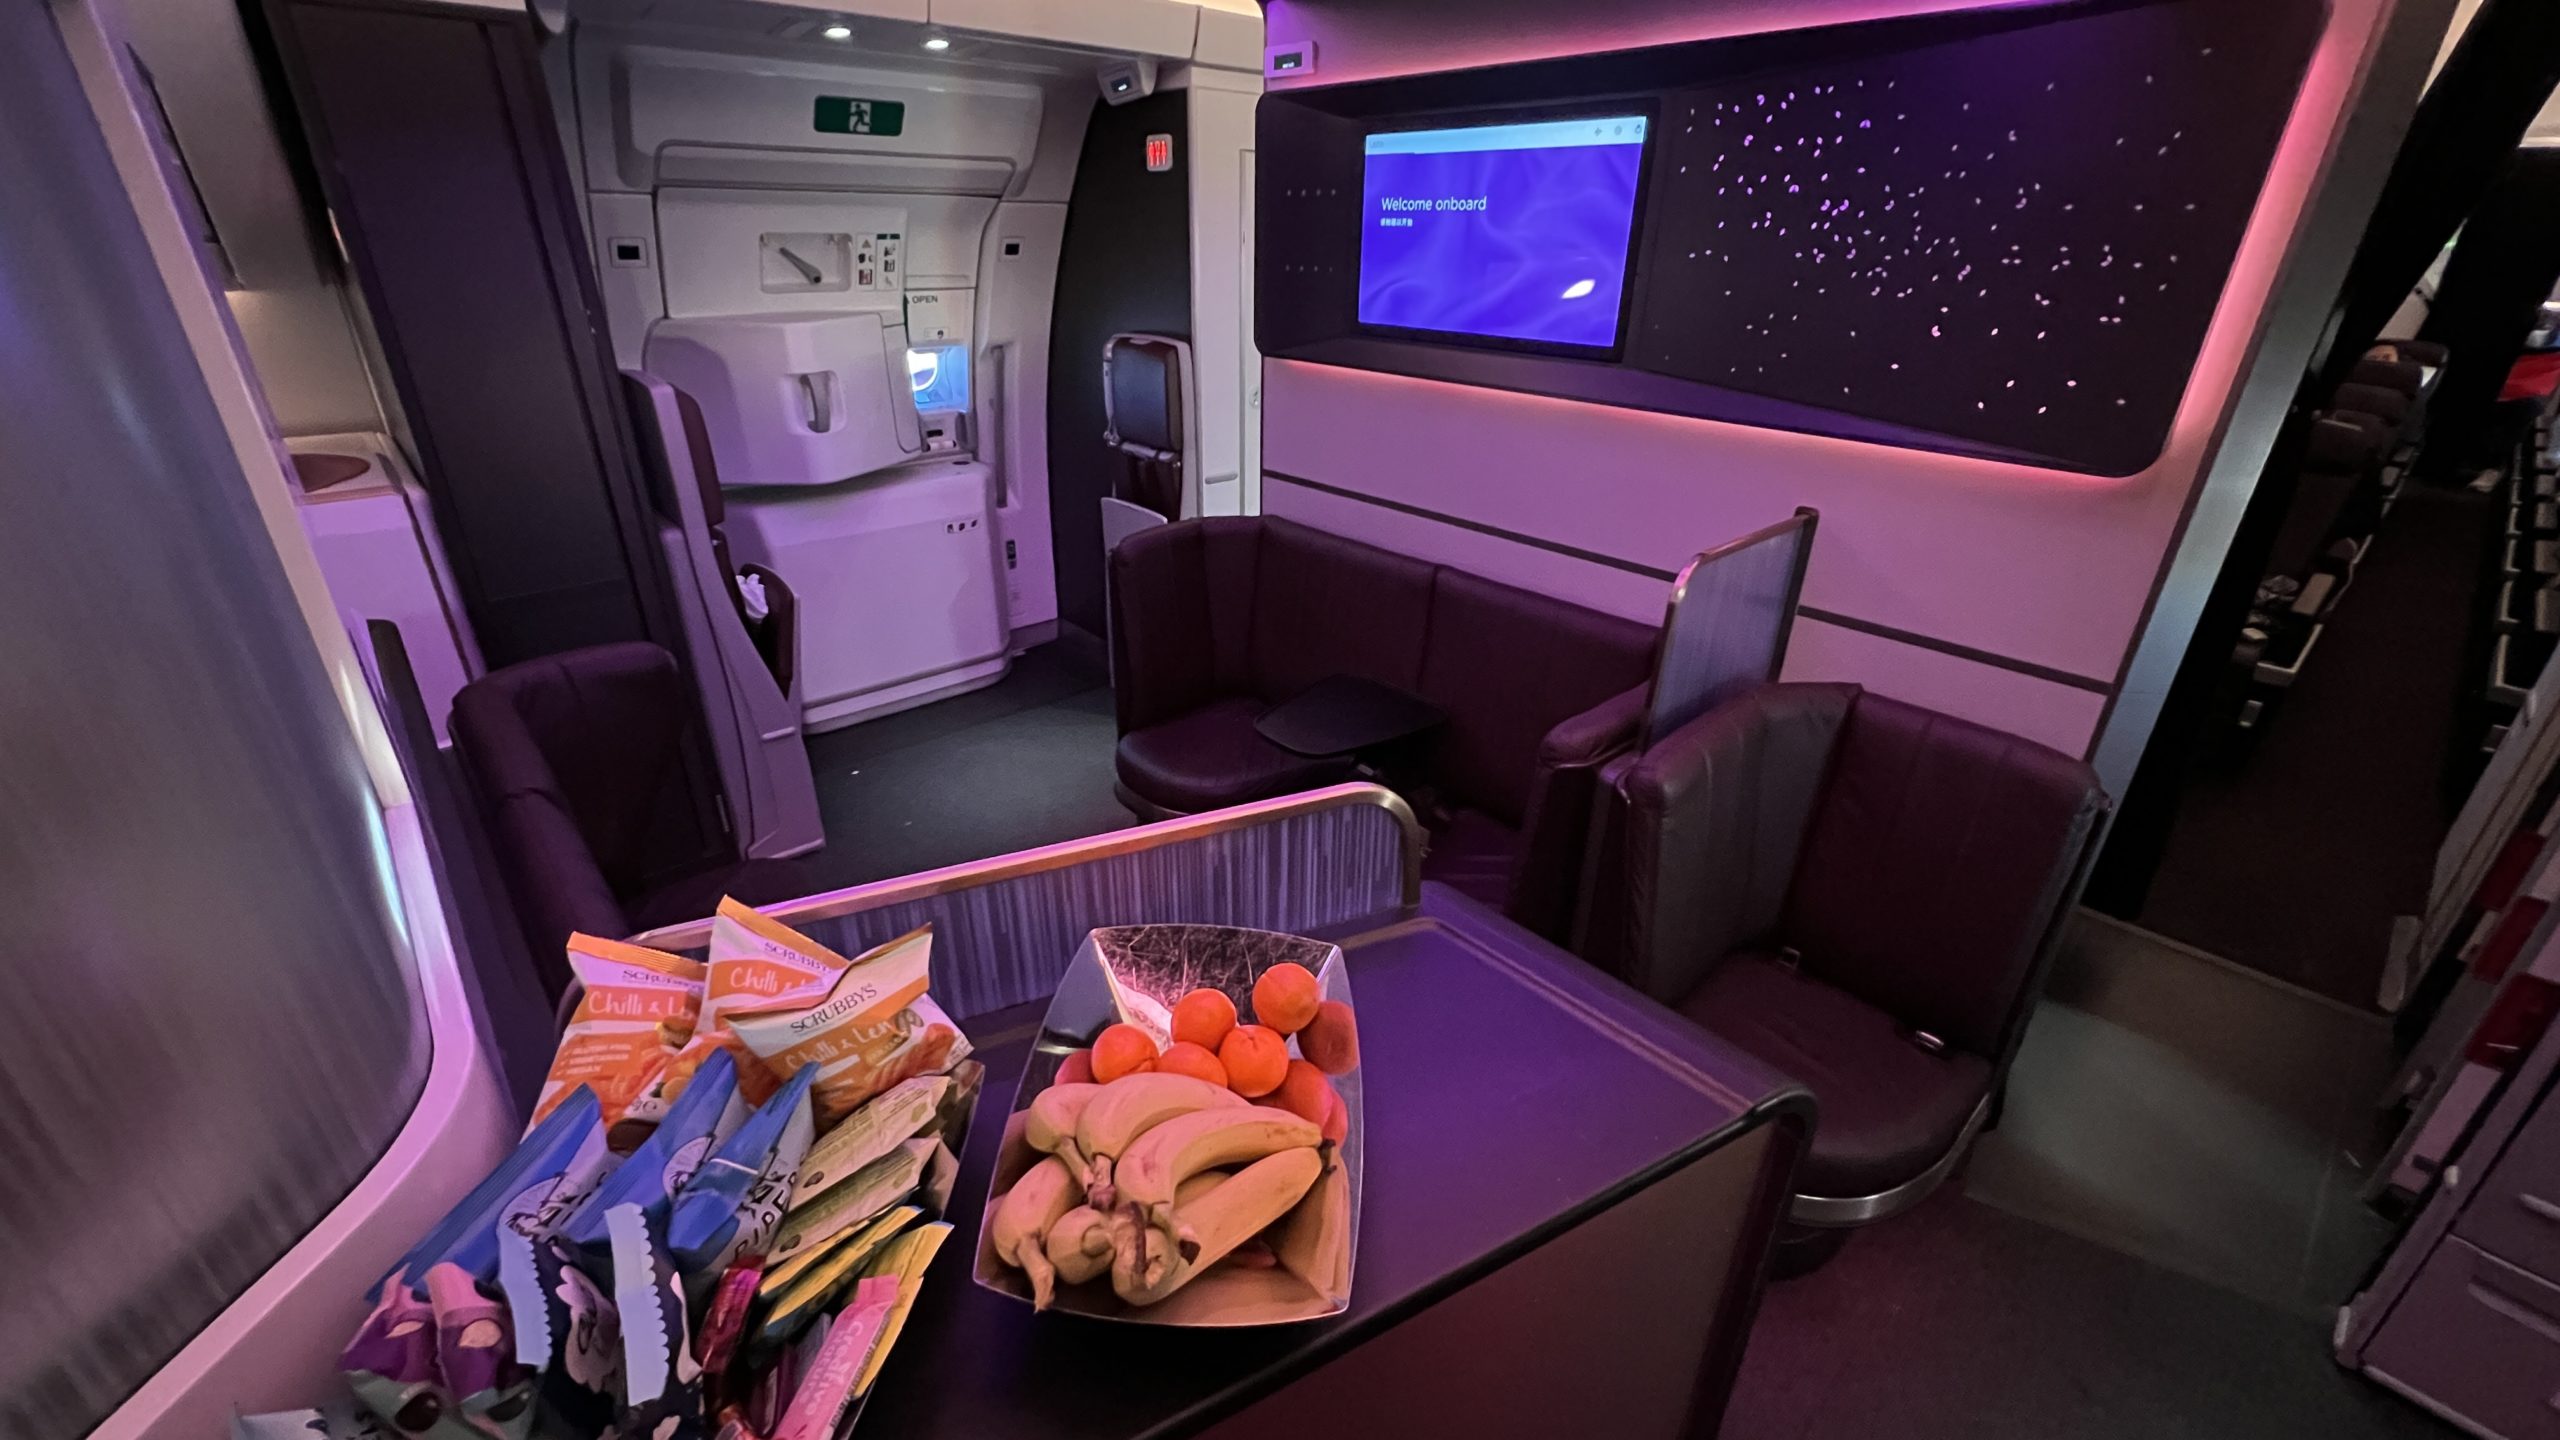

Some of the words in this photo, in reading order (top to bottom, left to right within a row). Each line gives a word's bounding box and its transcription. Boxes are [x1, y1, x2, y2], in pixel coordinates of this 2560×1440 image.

[1381, 197, 1432, 211] Welcome
[1435, 196, 1487, 211] onboard
[912, 295, 938, 304] OPEN
[588, 990, 643, 1016] Chilli
